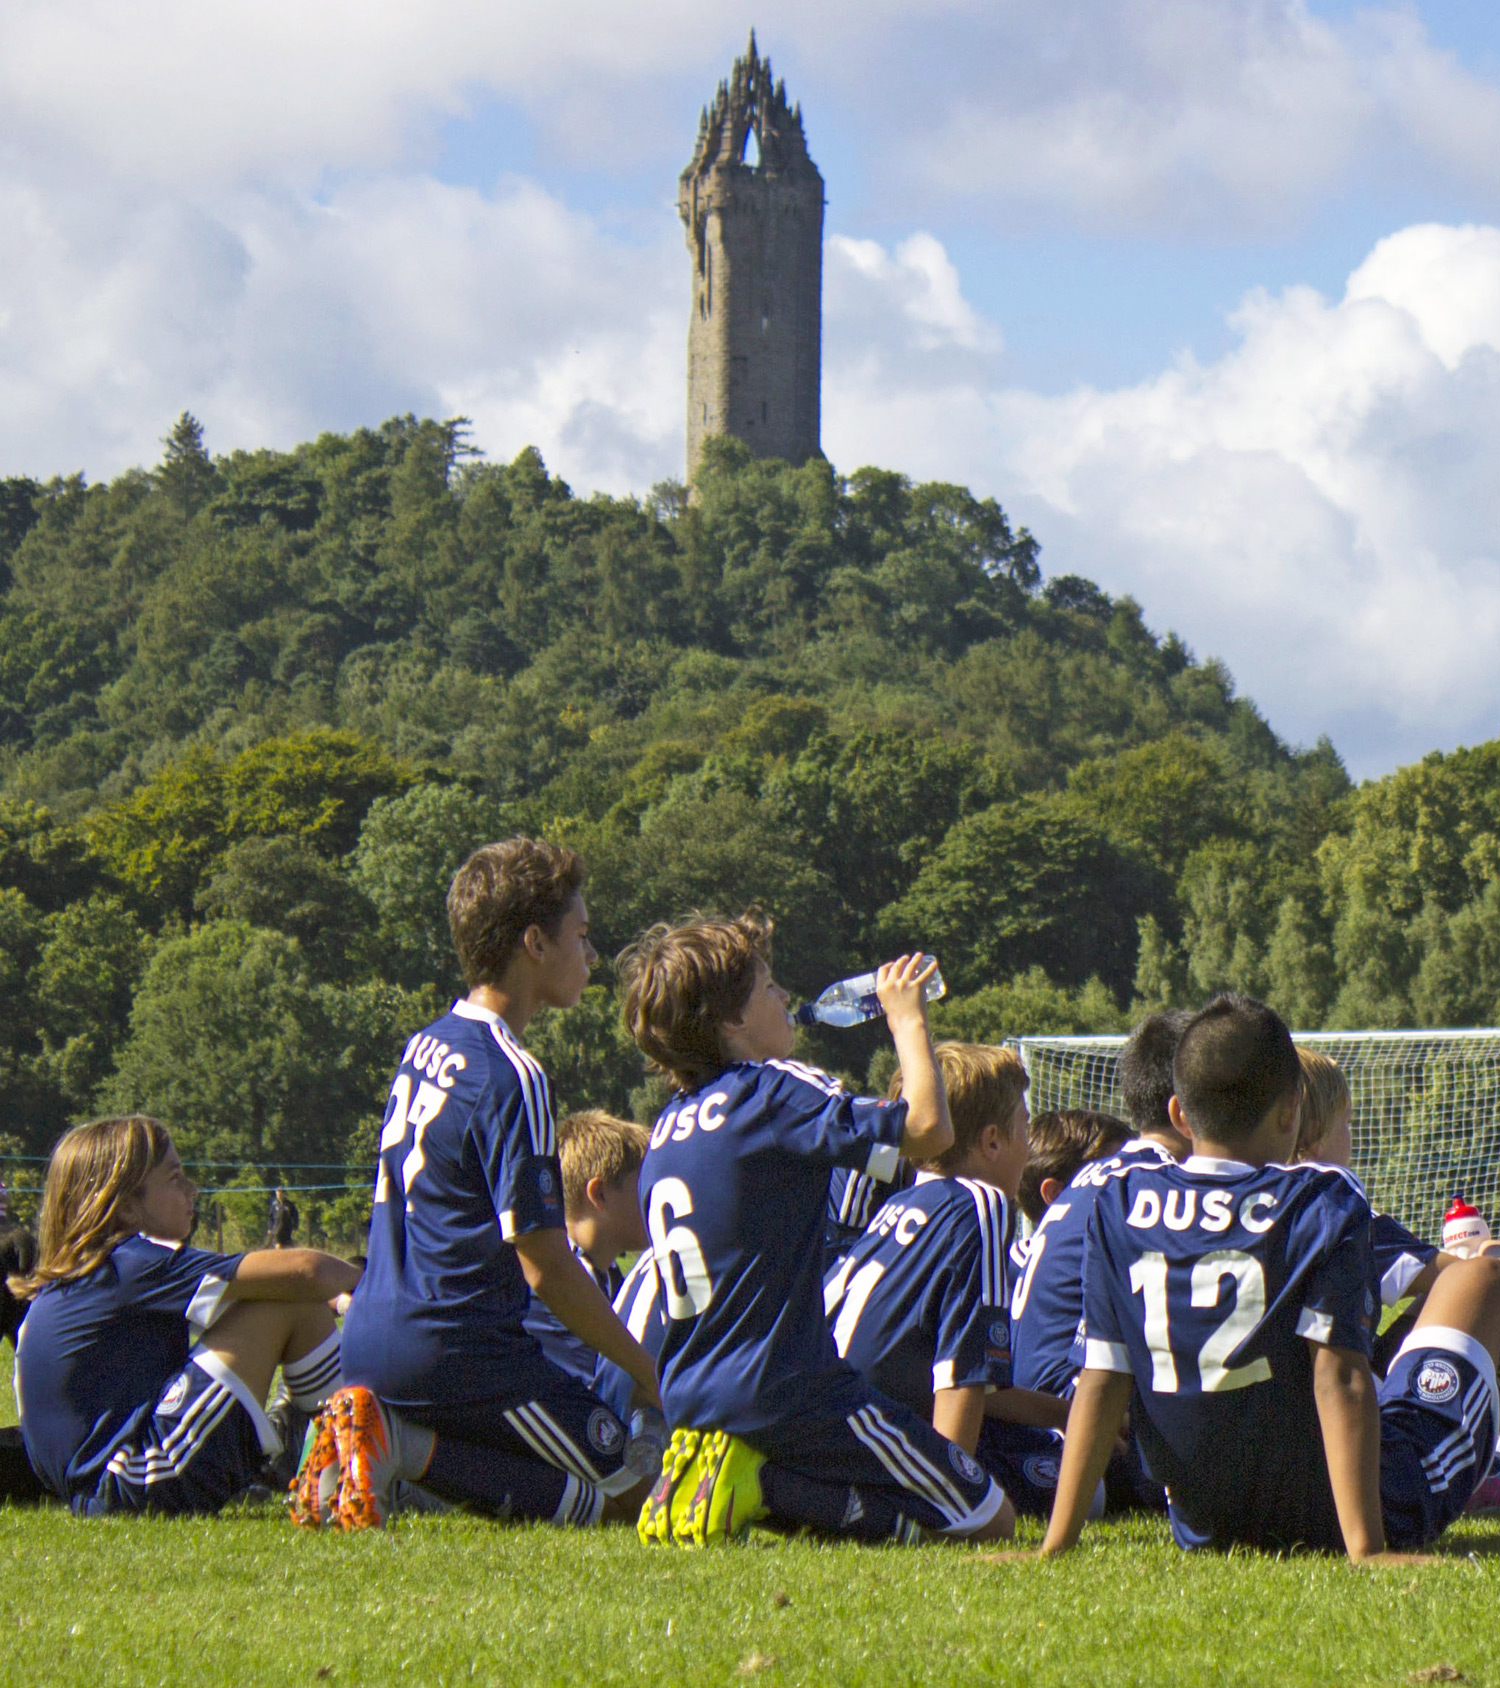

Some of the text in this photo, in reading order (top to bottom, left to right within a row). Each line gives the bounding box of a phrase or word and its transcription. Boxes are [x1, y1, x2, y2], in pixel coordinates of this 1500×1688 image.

[650, 1092, 728, 1150] USC
[867, 1204, 928, 1245] USC
[1126, 1190, 1278, 1233] DUSC
[648, 1176, 712, 1320] 6
[1128, 1250, 1273, 1393] 12
